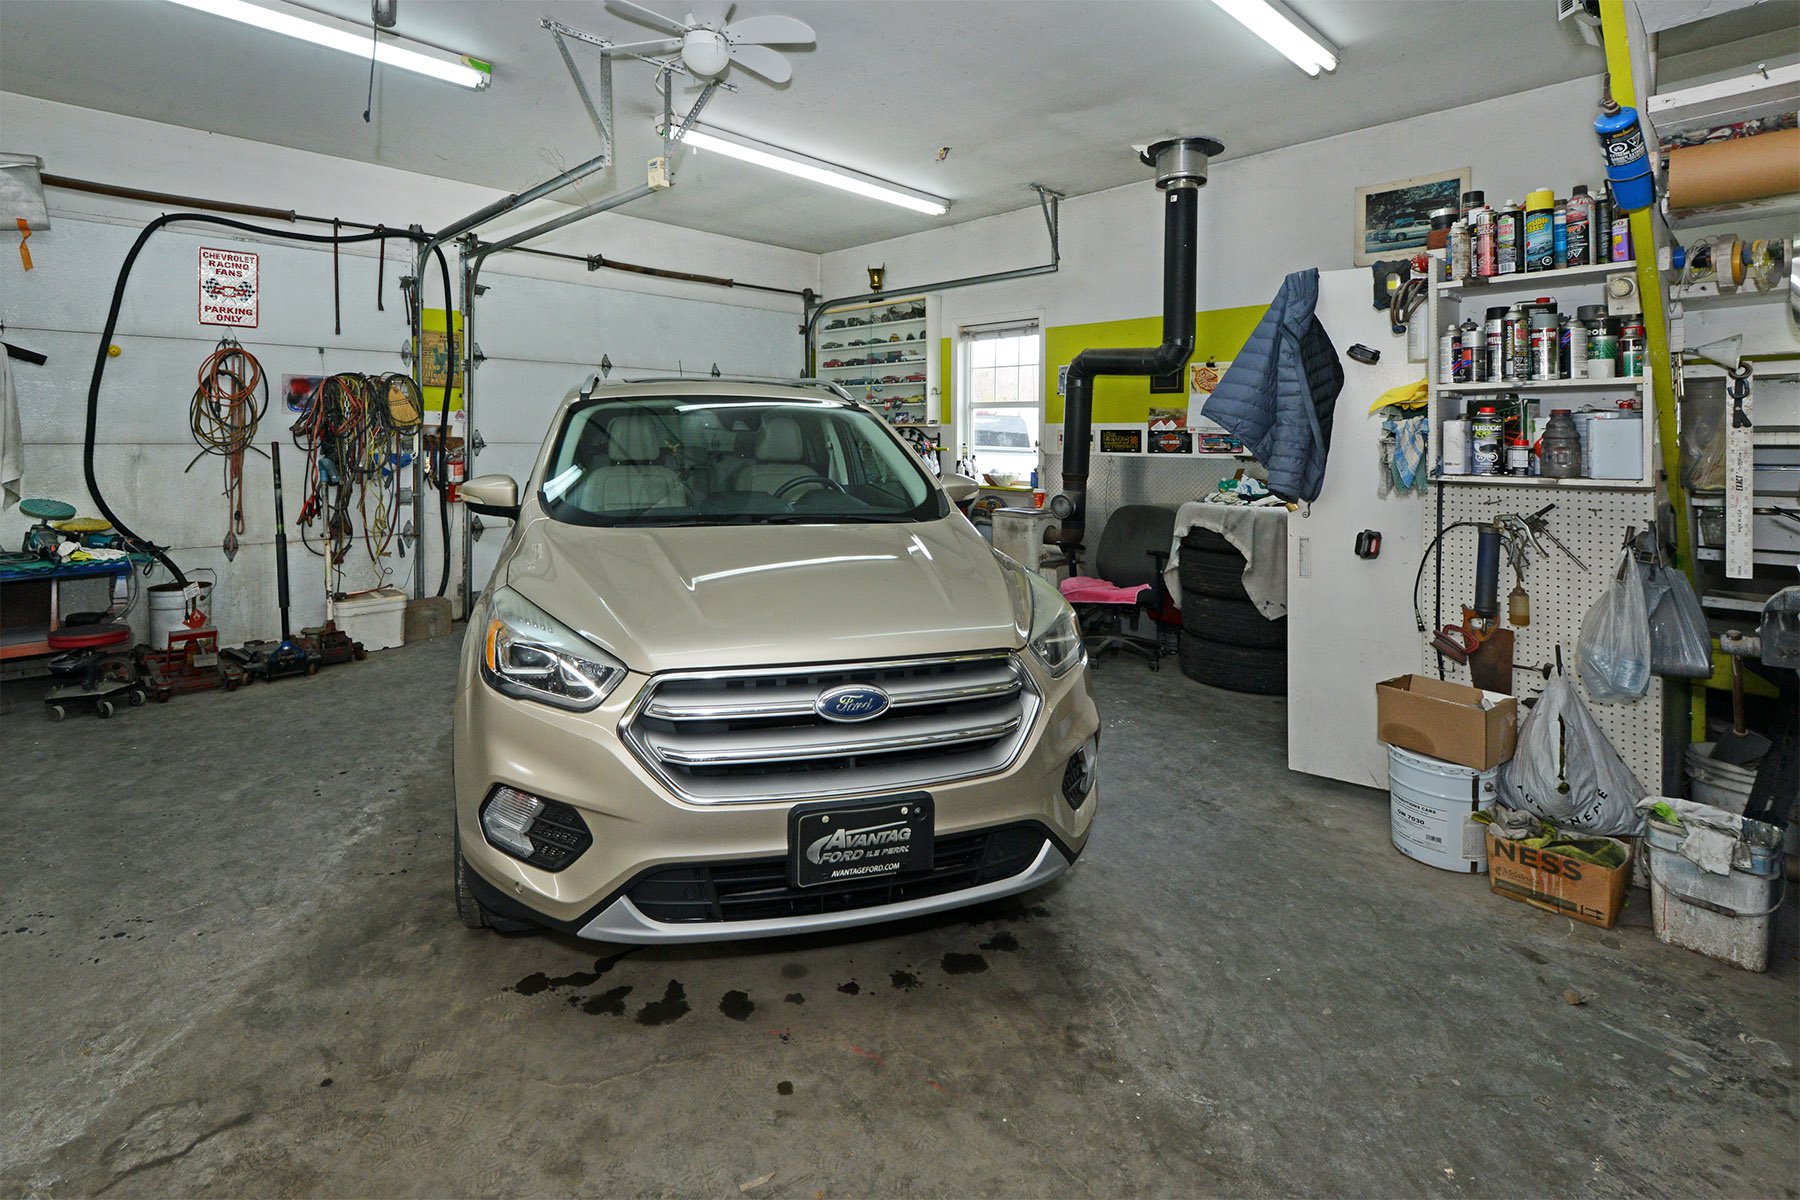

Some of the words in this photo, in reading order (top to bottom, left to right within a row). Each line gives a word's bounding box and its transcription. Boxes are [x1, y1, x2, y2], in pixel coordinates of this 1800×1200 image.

[202, 251, 255, 264] CHEVROLET
[208, 260, 250, 271] RACING
[215, 268, 243, 278] FANS
[204, 305, 253, 316] PARKING
[216, 314, 242, 323] ONLY
[1735, 475, 1744, 491] EXACT
[836, 694, 875, 713] Ford
[818, 849, 864, 865] FORD
[1494, 839, 1582, 881] NESS
[831, 862, 900, 878] AVANTAGEFORD.COM
